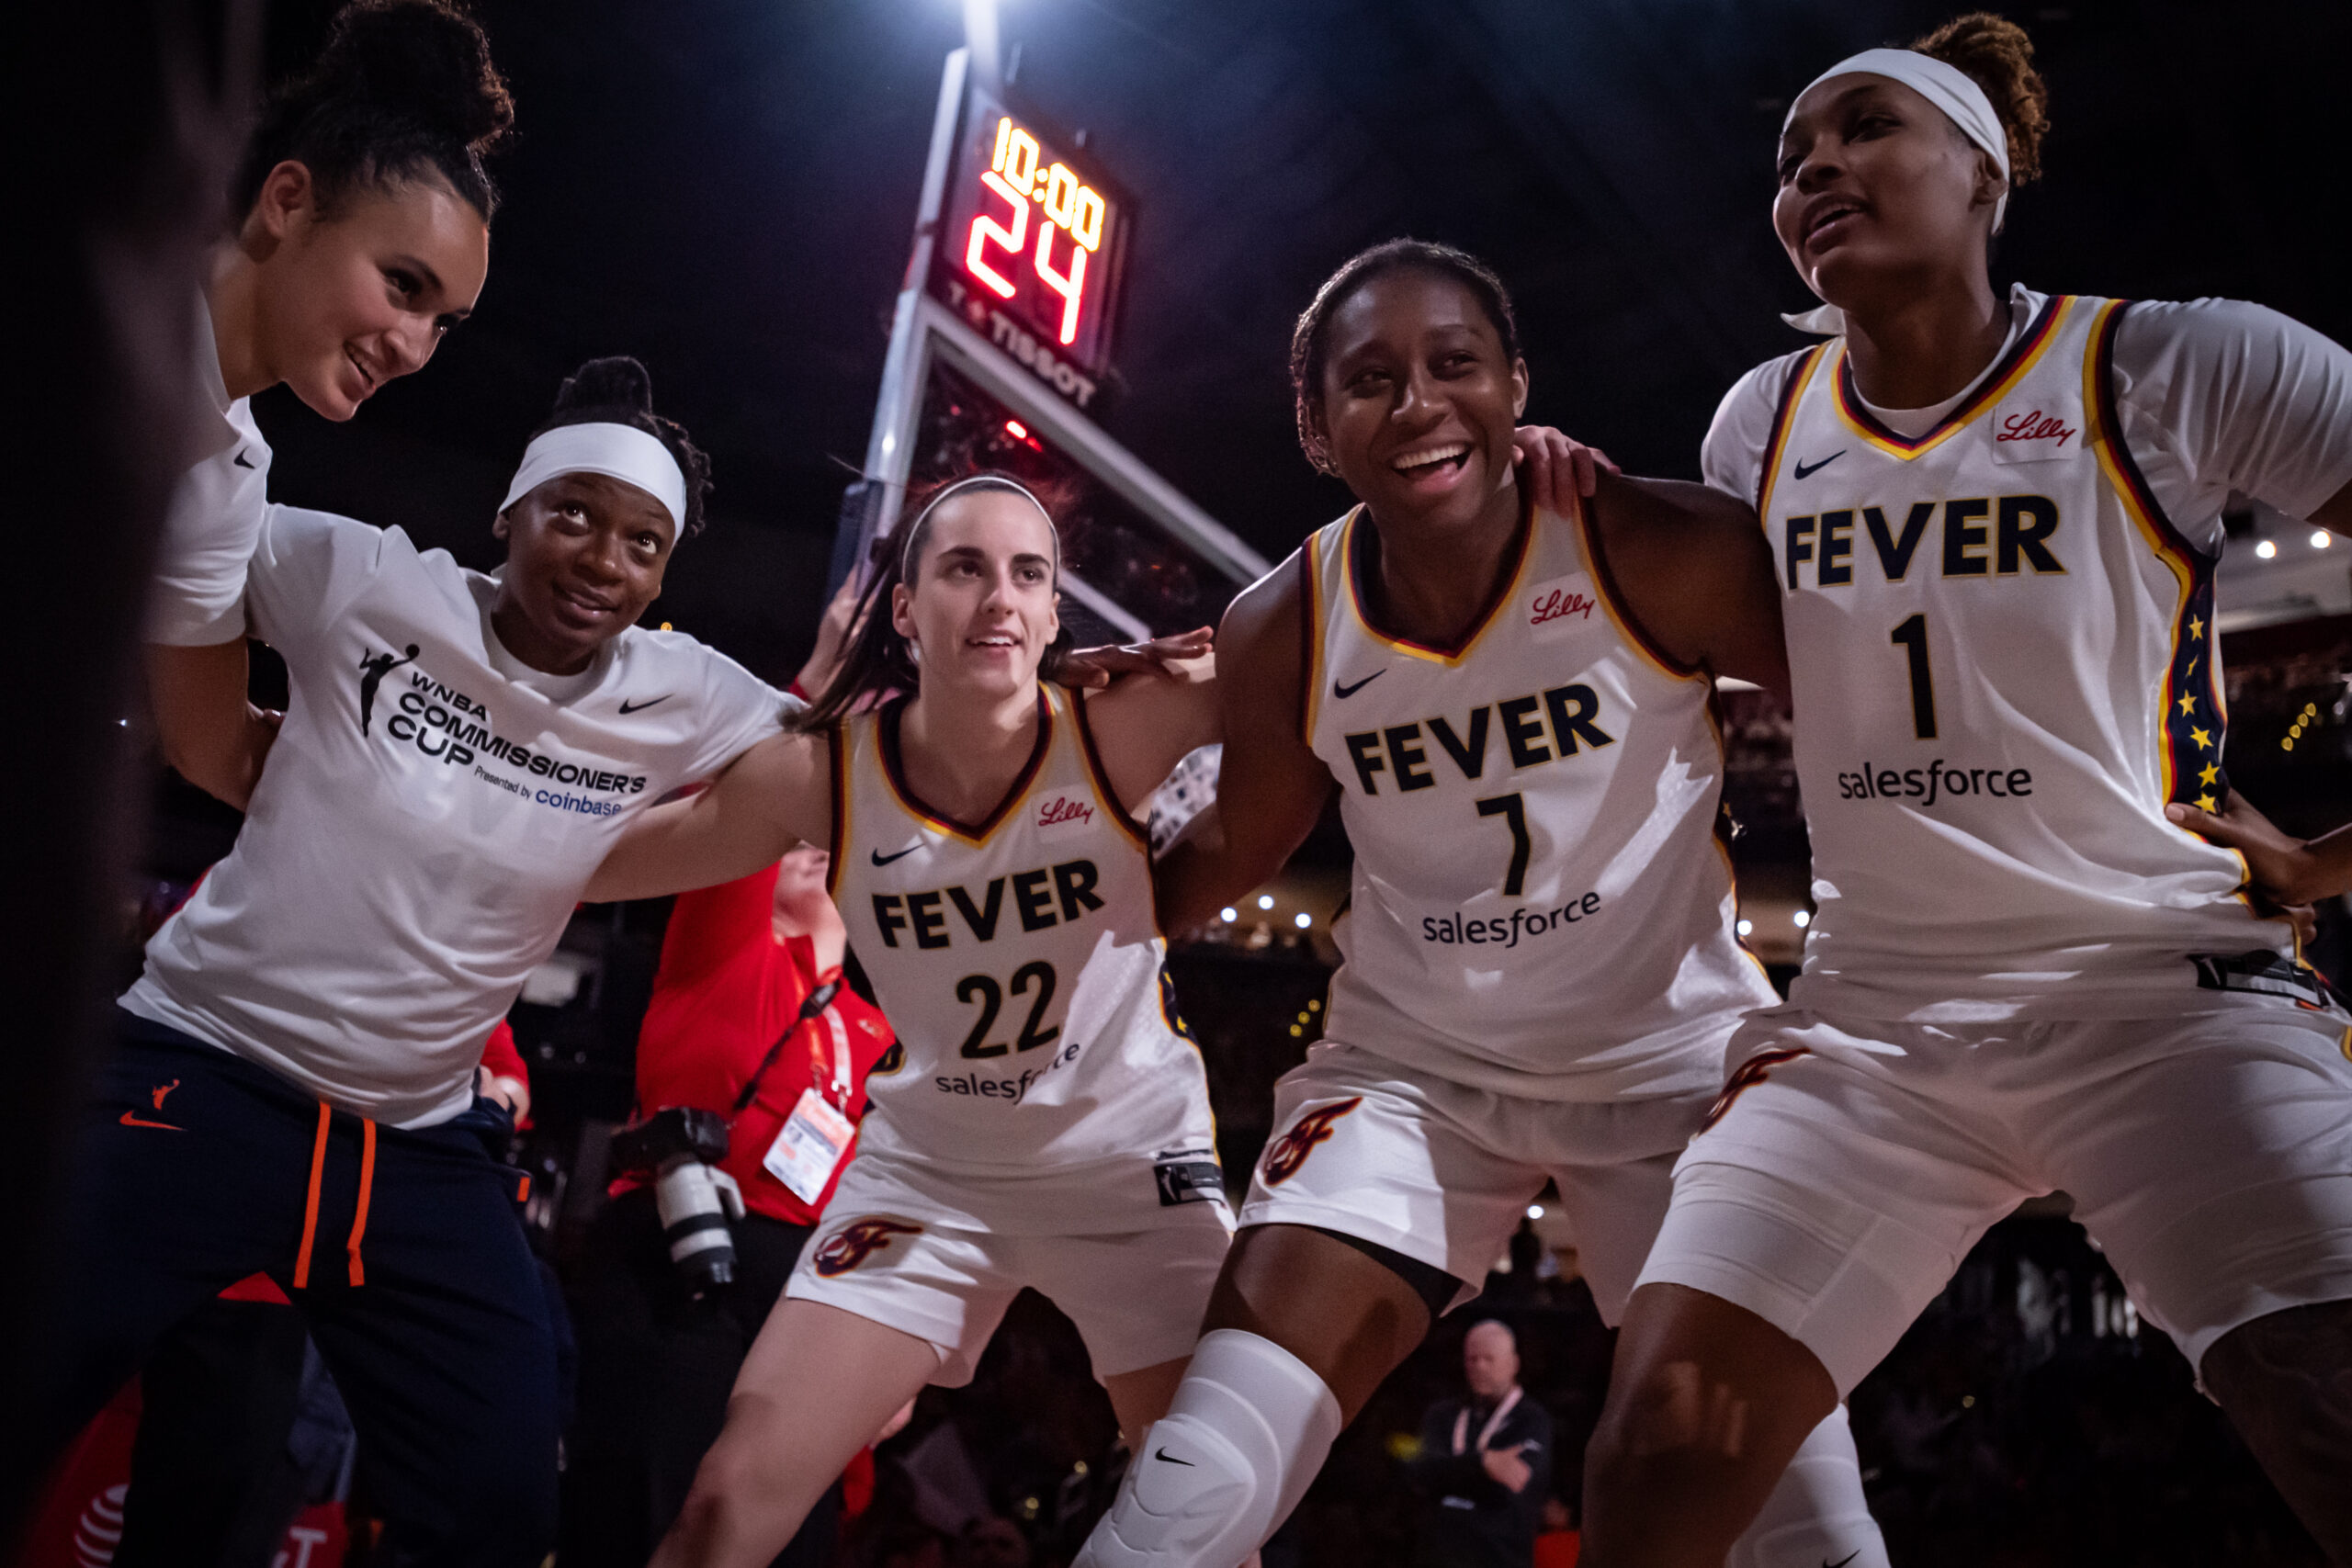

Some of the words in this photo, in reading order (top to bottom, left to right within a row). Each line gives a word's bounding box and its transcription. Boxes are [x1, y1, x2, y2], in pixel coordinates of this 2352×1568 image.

[991, 116, 1106, 253] 10:00
[966, 169, 1089, 345] 24
[989, 309, 1096, 407] TISSOT
[1996, 410, 2077, 447] Lilly
[1785, 494, 2069, 592] FEVER
[1530, 589, 1596, 626] Lilly
[412, 671, 487, 722] WNBA
[1890, 611, 1938, 740] 1
[387, 715, 474, 766] CUP
[399, 692, 647, 795] COMMISSIONER'S
[1344, 683, 1617, 796] FEVER
[1838, 759, 2033, 807] salesforce
[473, 764, 521, 794] Presented
[520, 784, 533, 801] by
[535, 789, 623, 817] coinbase
[1038, 797, 1095, 827] Lilly
[1476, 792, 1532, 897] 7
[871, 859, 1105, 950] FEVER
[1422, 891, 1601, 948] salesforce
[956, 960, 1060, 1060] 22
[935, 1043, 1080, 1106] salesfce
